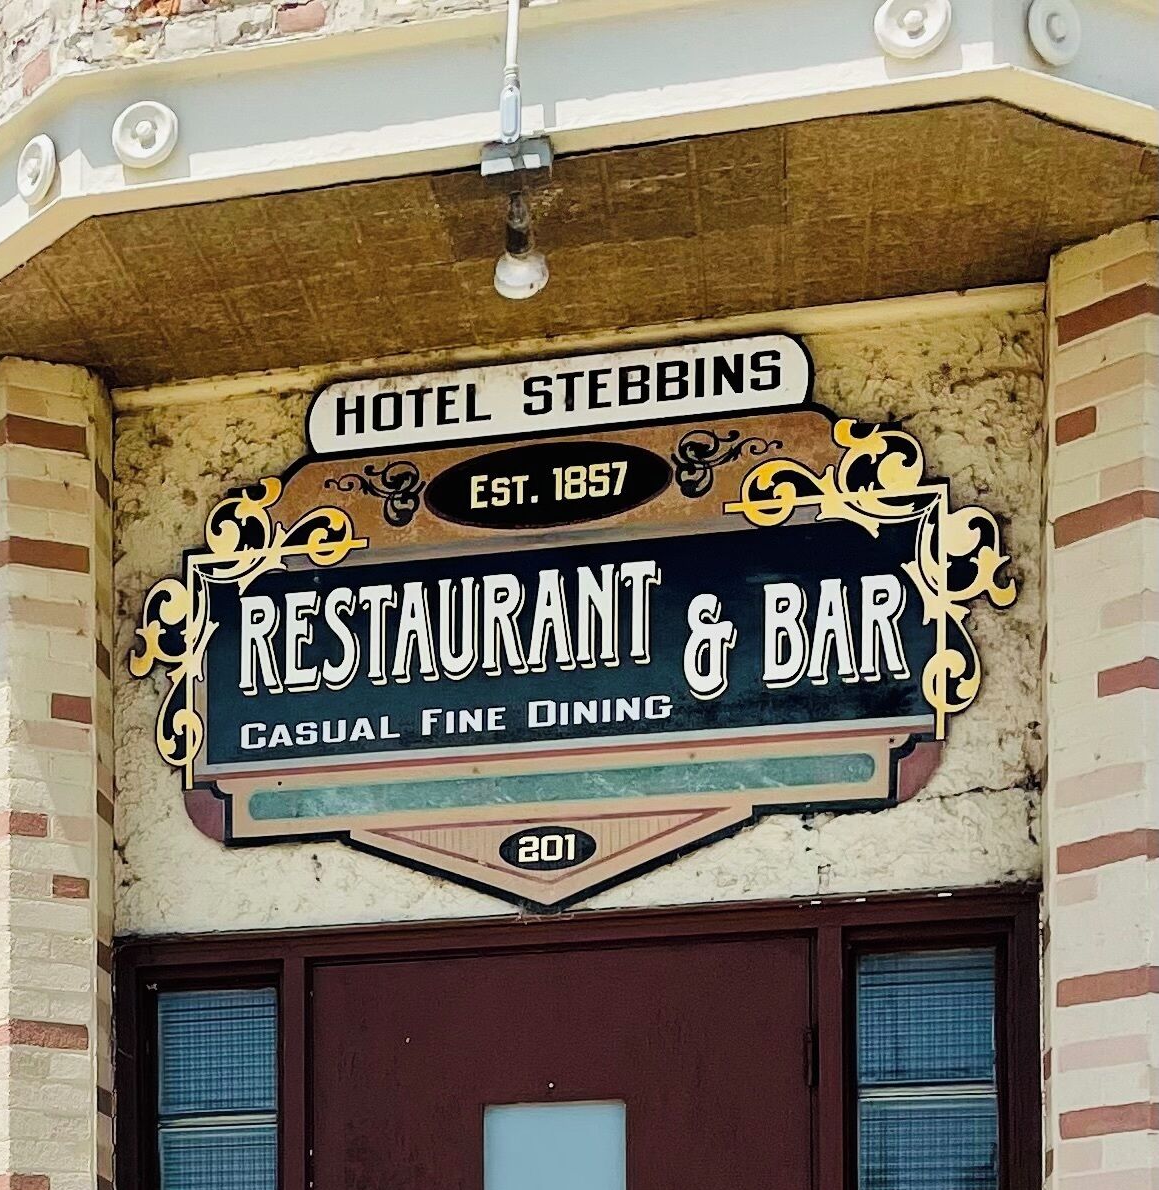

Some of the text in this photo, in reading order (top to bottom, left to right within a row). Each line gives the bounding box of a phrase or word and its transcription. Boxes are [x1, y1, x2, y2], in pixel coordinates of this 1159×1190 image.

[336, 349, 782, 436] HOTEL STEBBINS
[552, 461, 628, 501] 1857
[239, 560, 911, 700] RESTAURANT & BAR
[240, 694, 674, 750] CASUAL FINE DINING
[518, 833, 576, 863] 201
